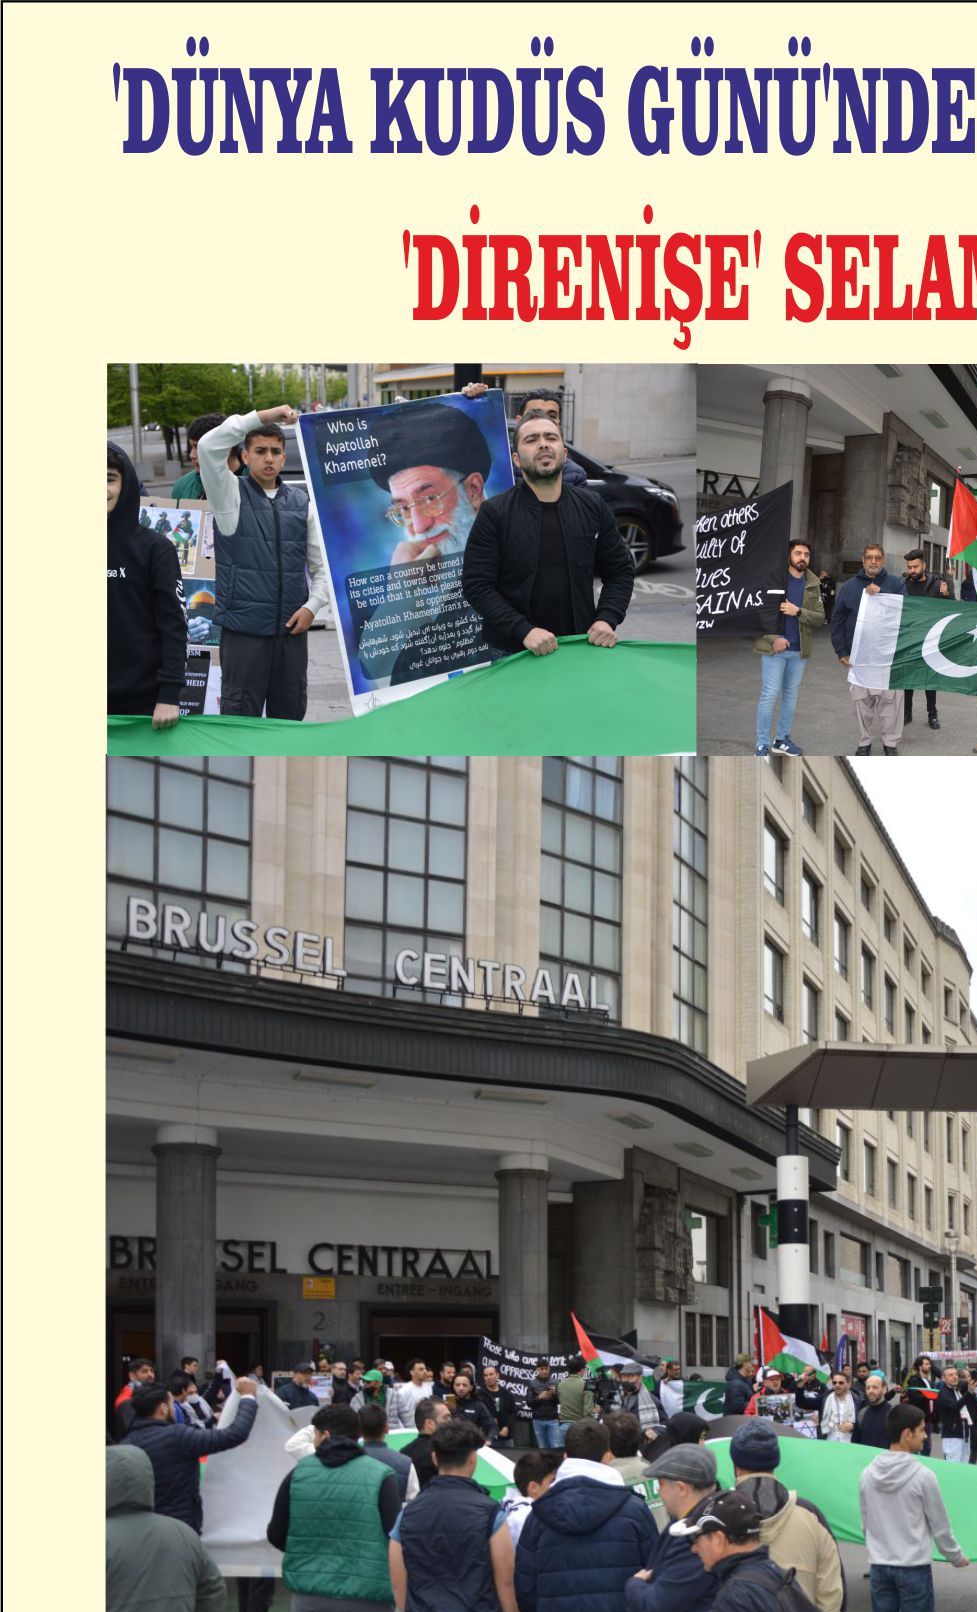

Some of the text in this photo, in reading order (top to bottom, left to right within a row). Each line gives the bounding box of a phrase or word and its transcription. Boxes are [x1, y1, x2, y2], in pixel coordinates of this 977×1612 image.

[327, 418, 368, 434] Who is
[326, 435, 379, 455] Ayatollah
[324, 453, 387, 475] Khamenei?
[349, 577, 367, 587] How
[370, 575, 385, 583] can
[394, 566, 424, 578] country
[426, 563, 436, 571] be
[438, 558, 459, 569] turned
[350, 589, 360, 599] its
[362, 585, 384, 596] cities
[386, 582, 401, 592] and
[404, 578, 427, 588] towns
[429, 571, 456, 583] covered
[357, 600, 367, 609] be
[370, 595, 385, 606] told
[387, 591, 403, 602] that
[406, 590, 412, 599] it
[413, 584, 439, 596] should
[416, 600, 424, 608] as
[127, 895, 610, 1011] BRUSSEL CENTRAAL
[109, 1235, 500, 1279] BRSEL CENTRAAL
